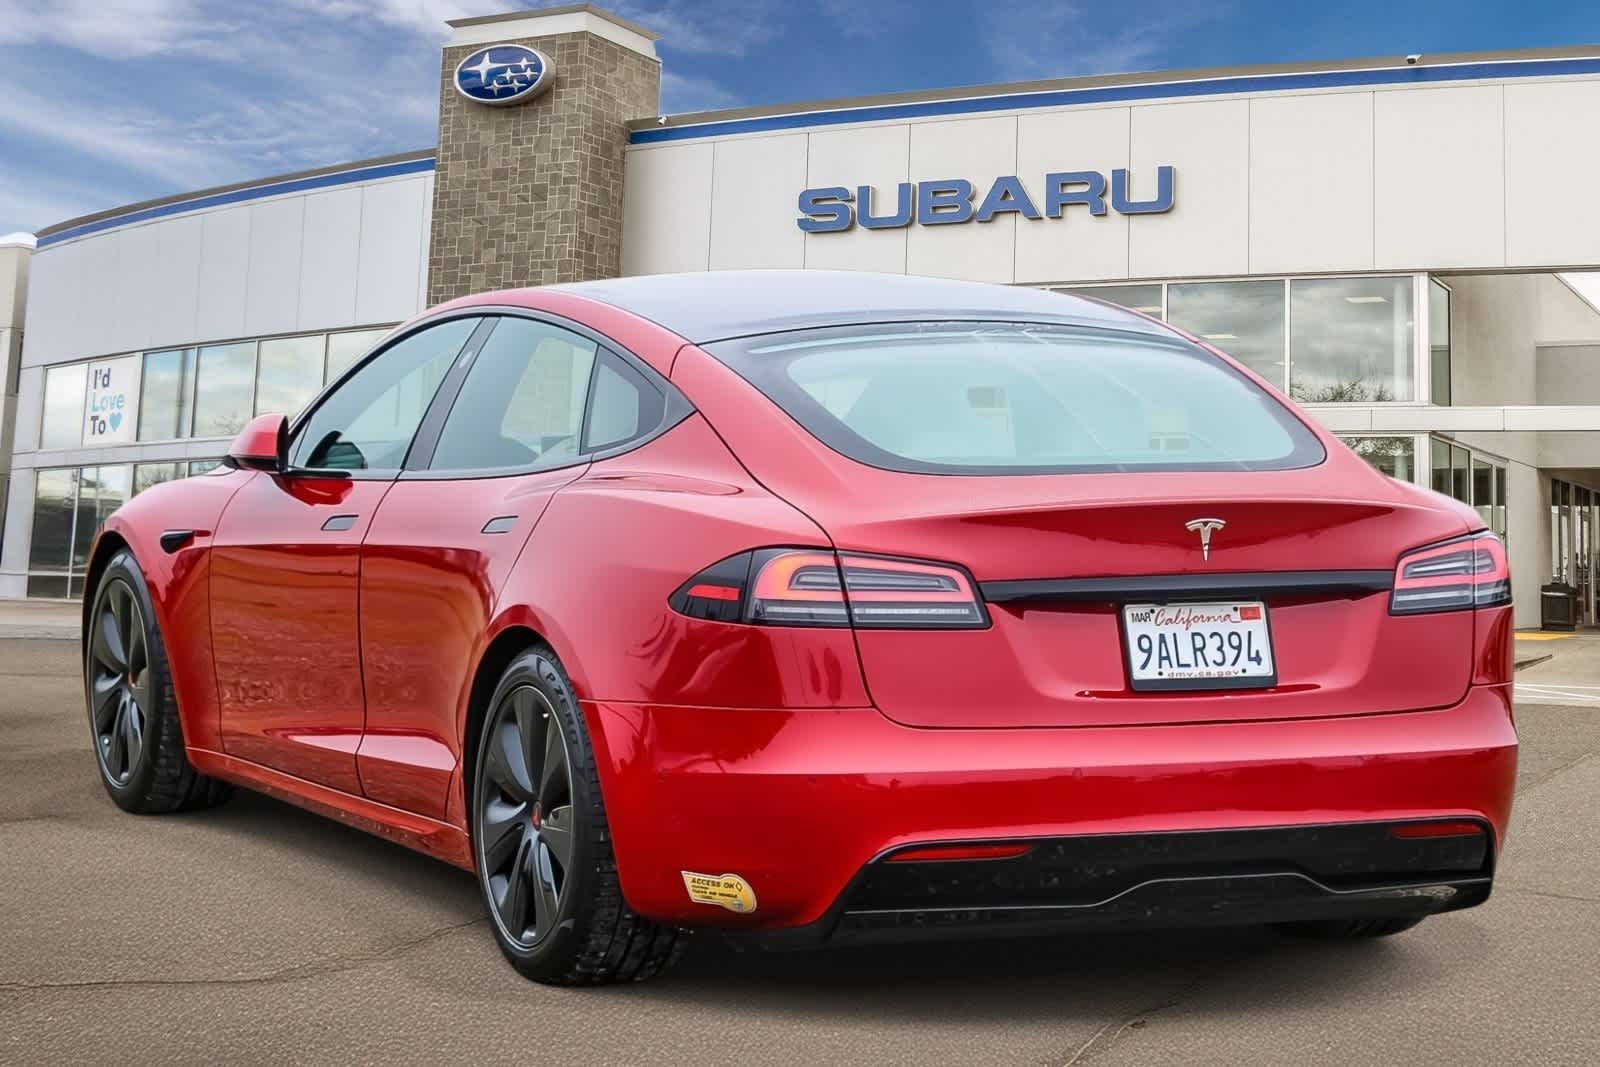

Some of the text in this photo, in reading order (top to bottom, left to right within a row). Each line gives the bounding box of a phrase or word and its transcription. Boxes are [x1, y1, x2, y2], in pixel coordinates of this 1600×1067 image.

[797, 165, 1176, 233] SUBARU
[93, 367, 111, 390] I'd
[91, 391, 125, 412] Love
[90, 415, 106, 435] To
[1131, 607, 1240, 630] MAR California
[1137, 630, 1263, 670] 9ALR394
[1167, 669, 1240, 679] dmv.ca.gov
[691, 877, 721, 888] ACCESS
